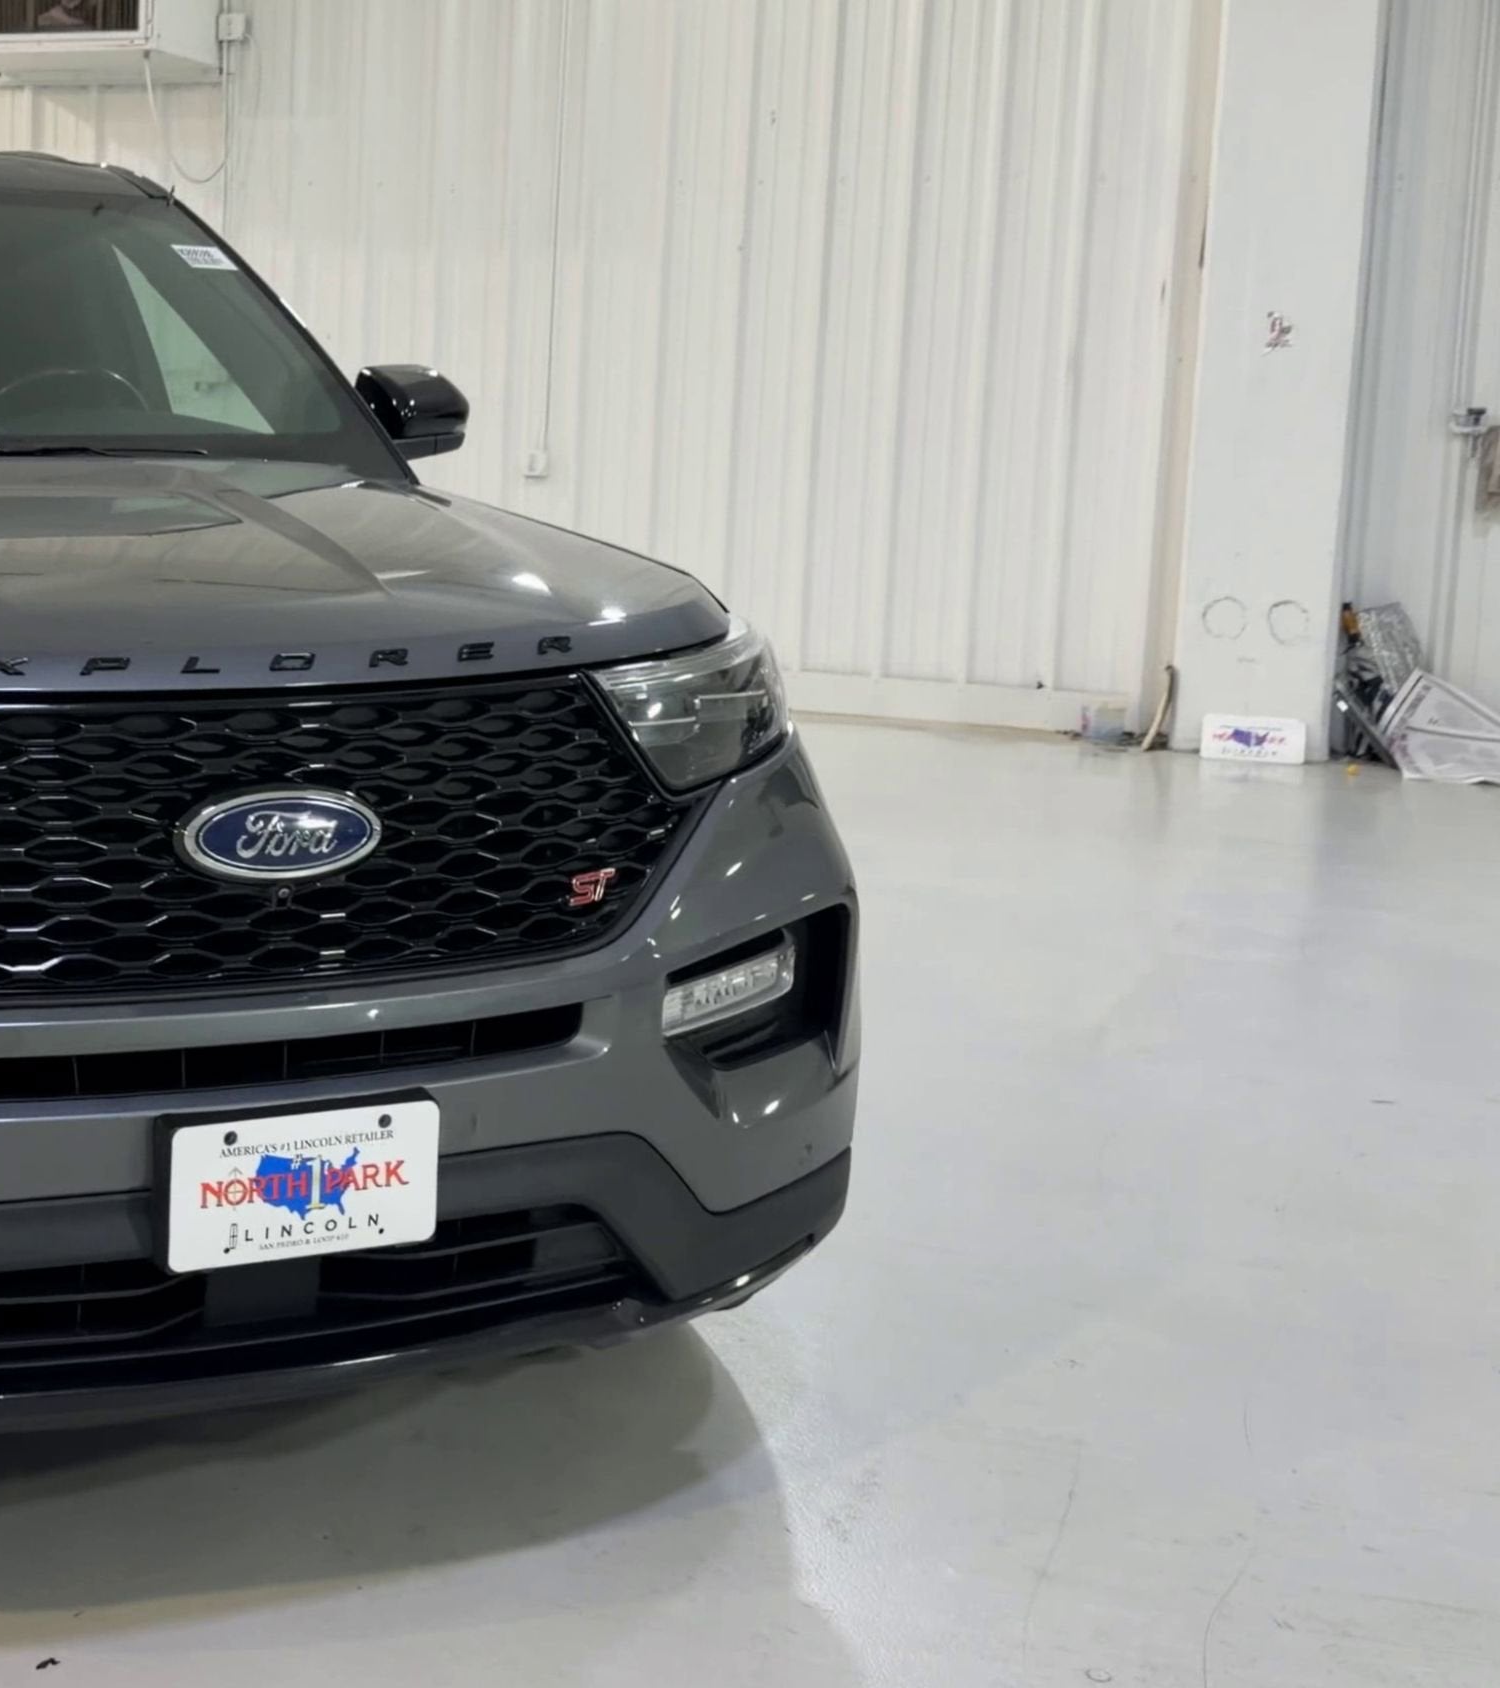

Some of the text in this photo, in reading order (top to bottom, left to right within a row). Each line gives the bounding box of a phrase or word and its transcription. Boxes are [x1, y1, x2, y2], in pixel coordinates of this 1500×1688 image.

[236, 810, 338, 859] Ford
[568, 867, 616, 907] ST
[219, 1130, 395, 1158] AMERICA'S #1 LINCOLN RETAILER
[200, 1160, 409, 1209] NORTH PARK
[244, 1214, 380, 1242] LINCOLN
